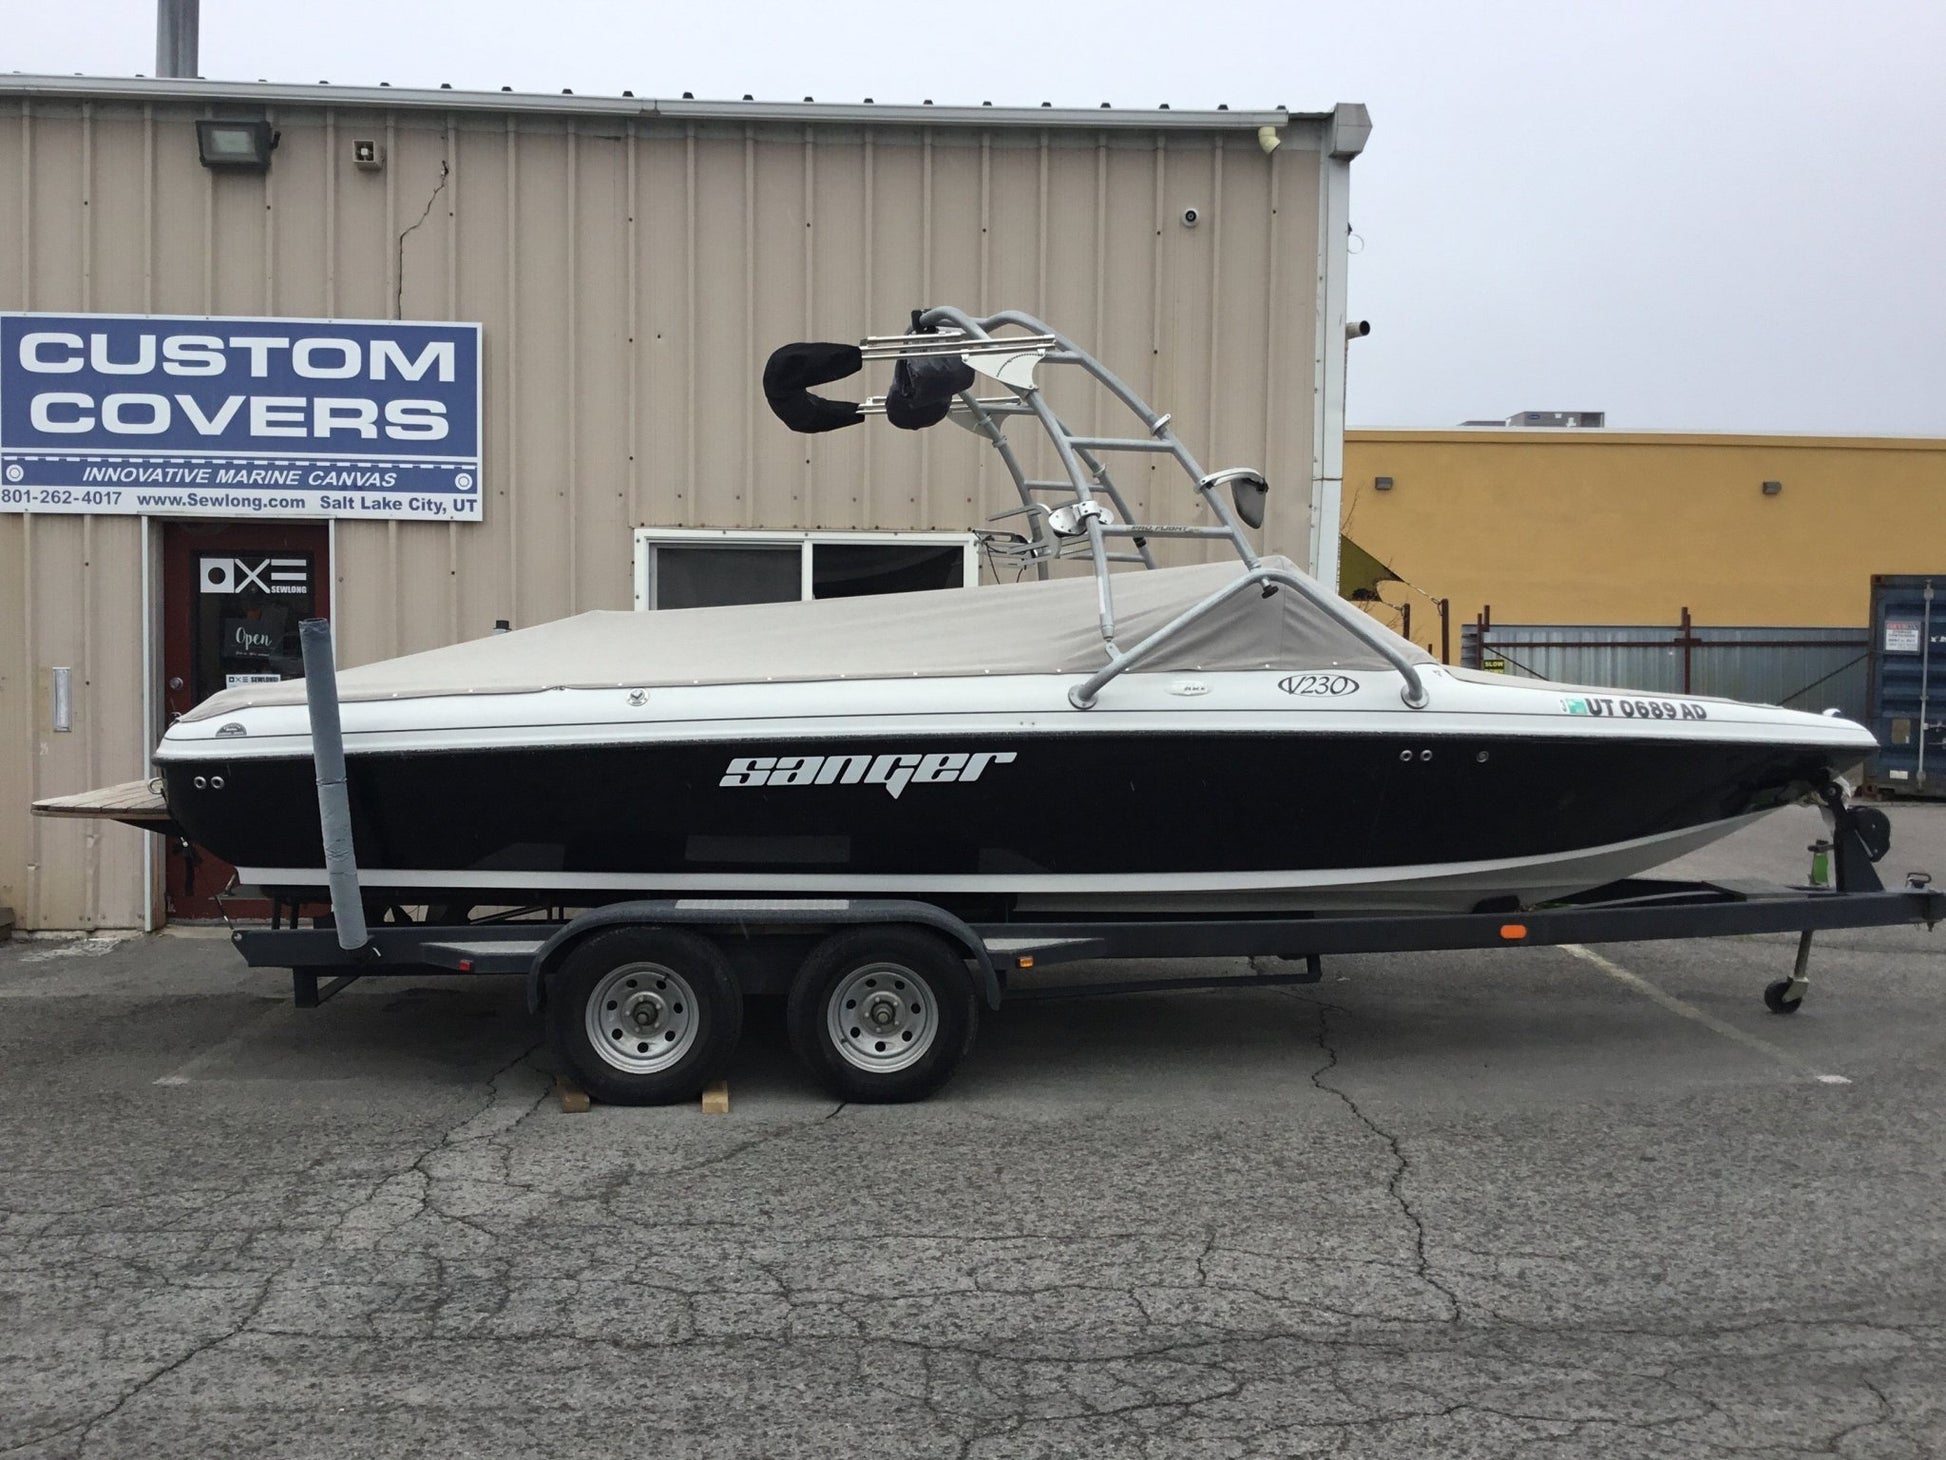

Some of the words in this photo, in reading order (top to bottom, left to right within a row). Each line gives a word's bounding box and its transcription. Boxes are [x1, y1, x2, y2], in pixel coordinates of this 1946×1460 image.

[19, 332, 455, 382] CUSTOM
[29, 391, 450, 441] COVERS
[82, 466, 212, 484] INNOVATIVE
[215, 469, 302, 486] MARINE
[308, 470, 397, 488] CANVAS
[1, 488, 122, 506] 801-262-4017
[136, 492, 306, 511] www.Sewlong.com
[320, 495, 355, 510] Salt
[360, 496, 403, 511] Lake
[408, 497, 447, 515] City,
[453, 499, 477, 513] UT
[271, 585, 307, 594] SEWLONG
[235, 626, 272, 651] Open
[1285, 676, 1350, 695] V230
[1585, 698, 1614, 717] UT
[1619, 699, 1677, 720] 0689
[1681, 703, 1708, 720] AD
